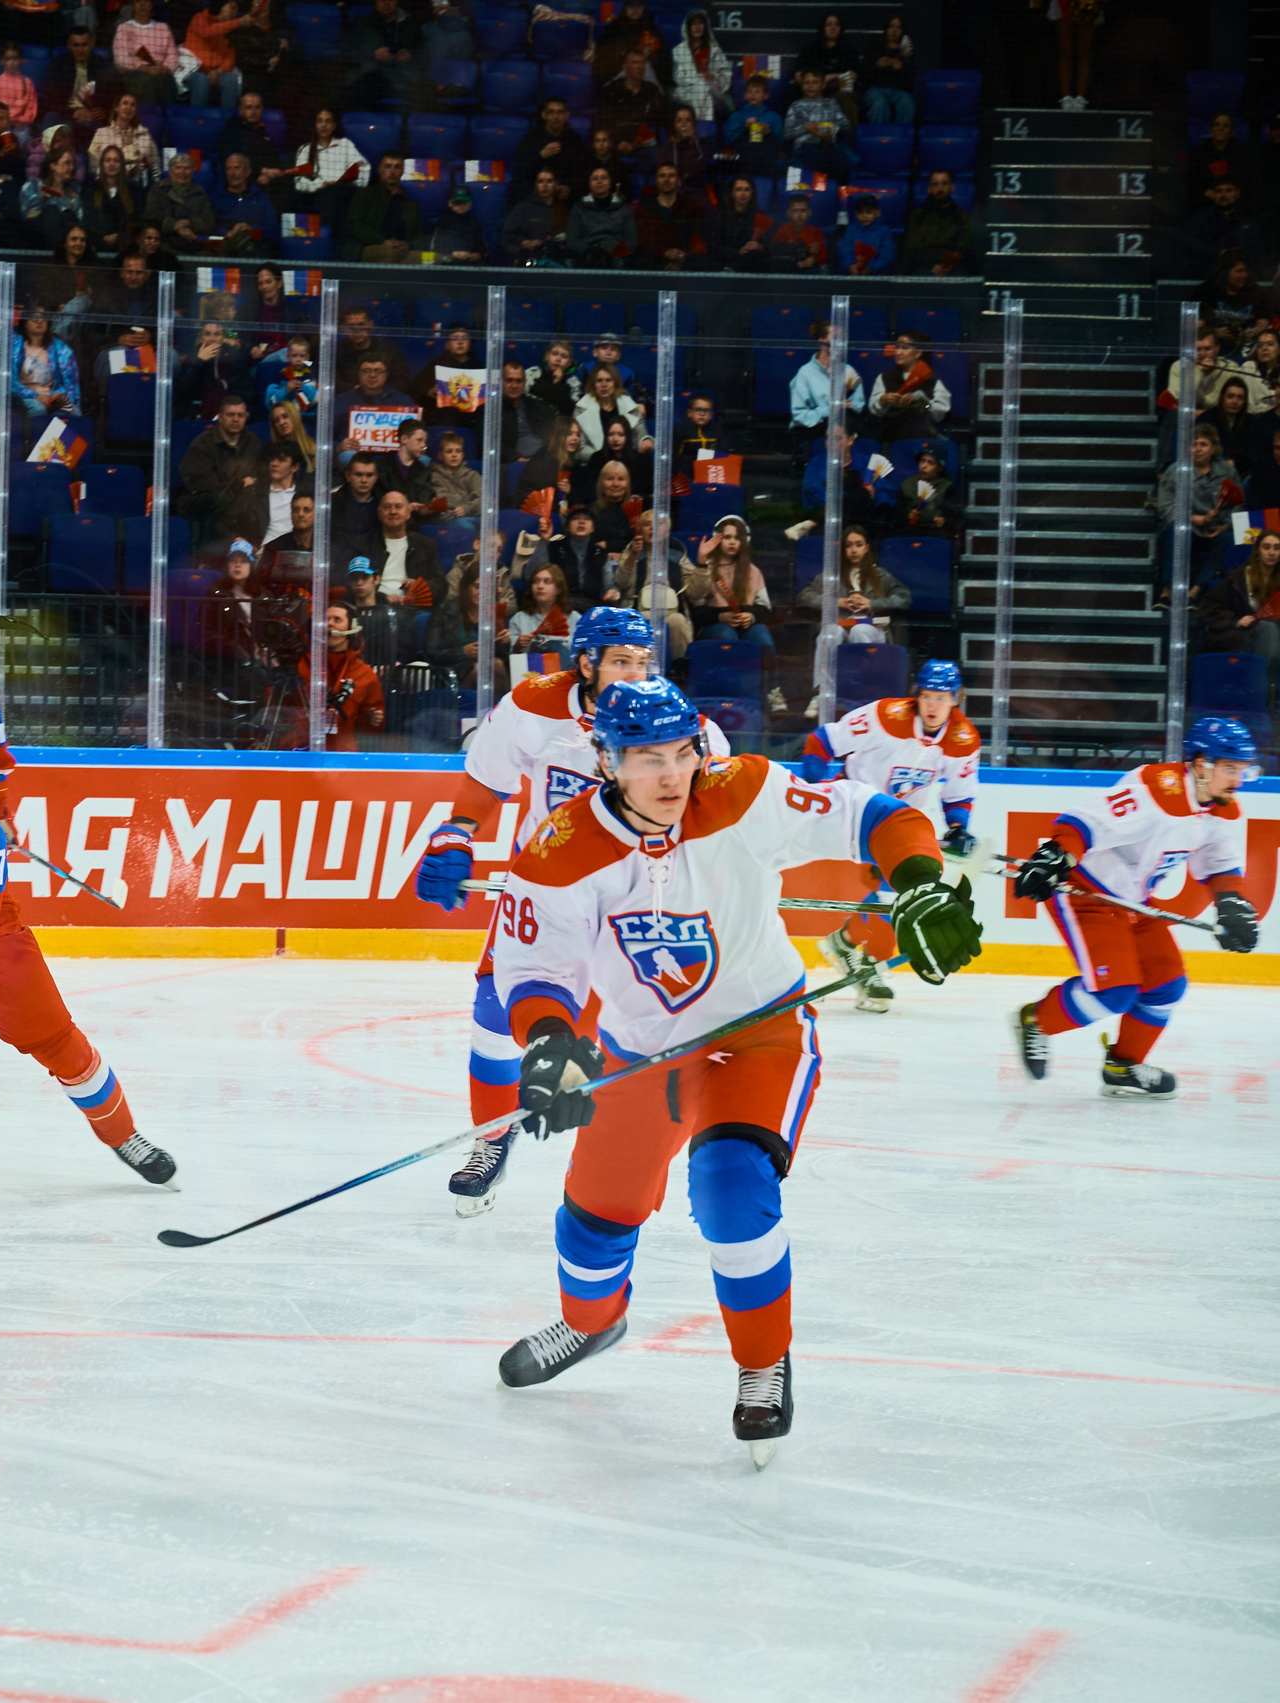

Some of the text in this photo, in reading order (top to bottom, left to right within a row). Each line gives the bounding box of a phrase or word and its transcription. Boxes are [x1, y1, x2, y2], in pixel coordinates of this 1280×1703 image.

[717, 11, 743, 28] 16
[1002, 118, 1029, 138] 14
[1118, 118, 1145, 139] 14
[994, 172, 1022, 194] 13
[1118, 173, 1146, 195] 13
[990, 232, 1017, 254] 12
[1117, 233, 1144, 255] 12
[1117, 294, 1141, 318] 11
[354, 413, 414, 427] СТУДЕ
[352, 428, 400, 443] ВПЕРЕ
[653, 714, 681, 726] CCM
[549, 770, 599, 796] СХ
[1106, 788, 1140, 818] 16
[149, 797, 520, 900] МАШИН
[502, 893, 539, 946] 98
[615, 915, 709, 941] СХЛ
